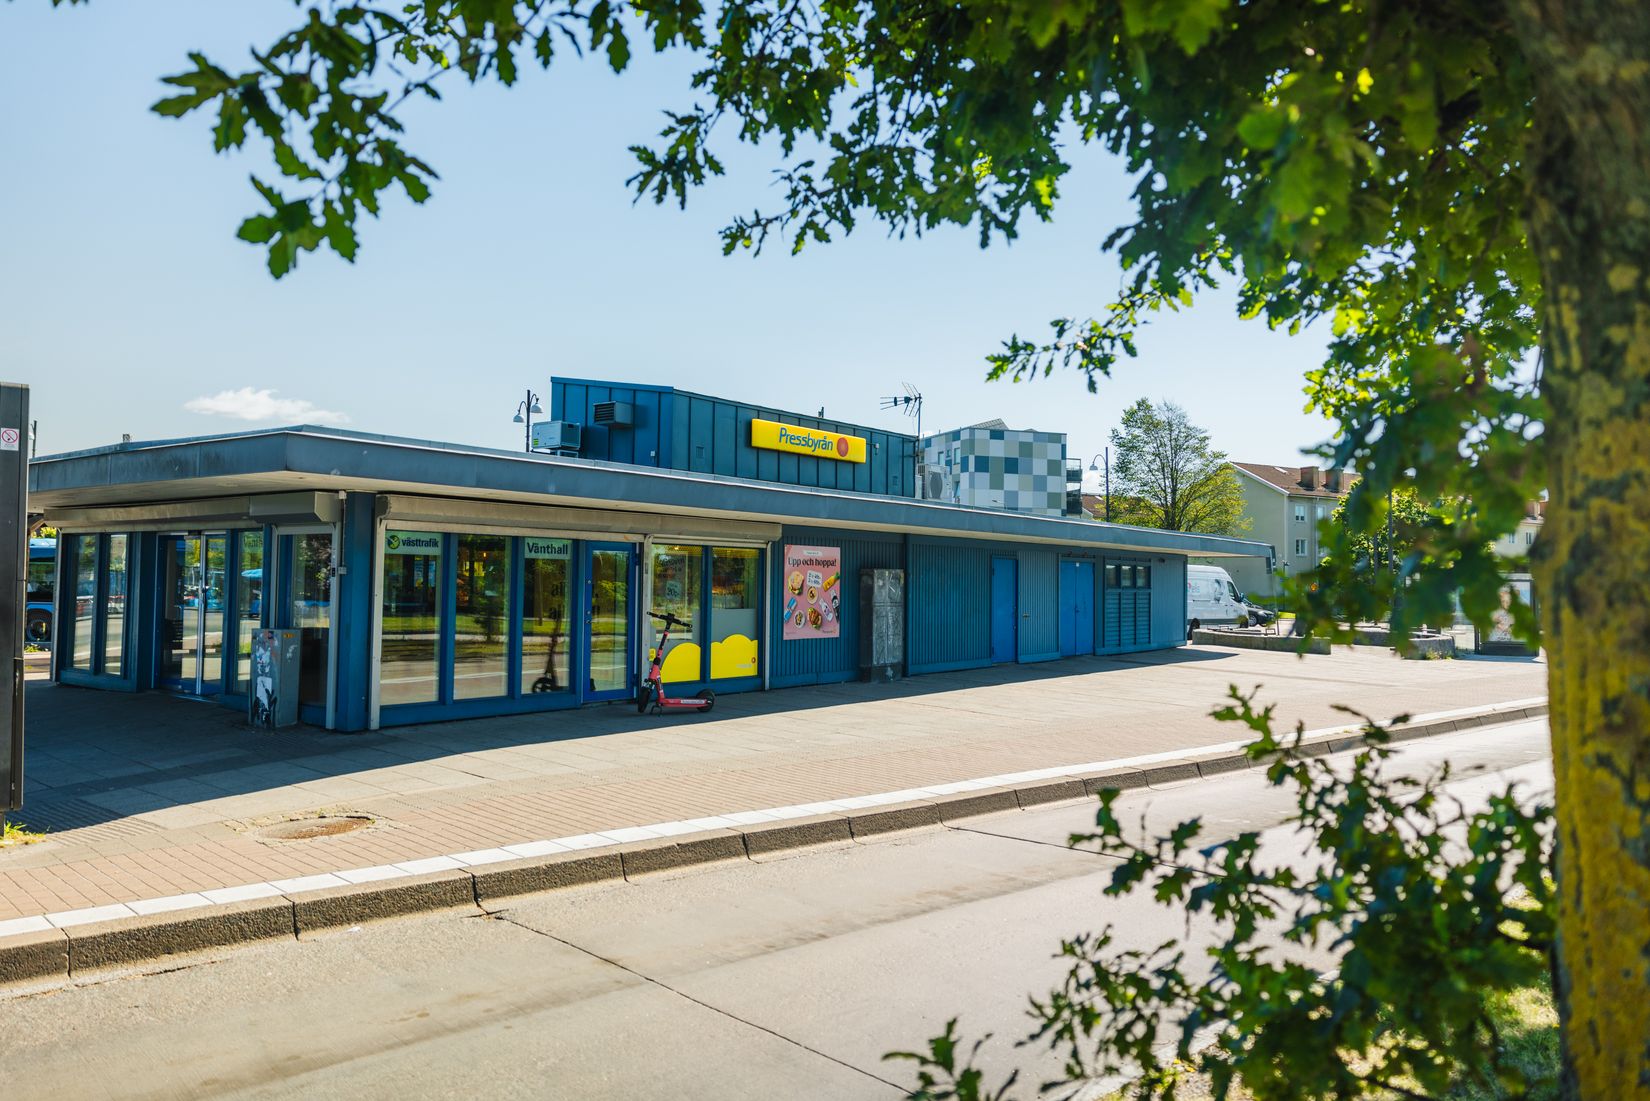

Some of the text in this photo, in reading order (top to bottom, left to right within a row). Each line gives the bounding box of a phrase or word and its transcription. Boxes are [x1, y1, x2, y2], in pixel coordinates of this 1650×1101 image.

[779, 427, 833, 452] Pressbyrån
[402, 538, 439, 548] västtrafik
[527, 541, 569, 556] Vänthall
[787, 557, 837, 568] Upp och hoppa!
